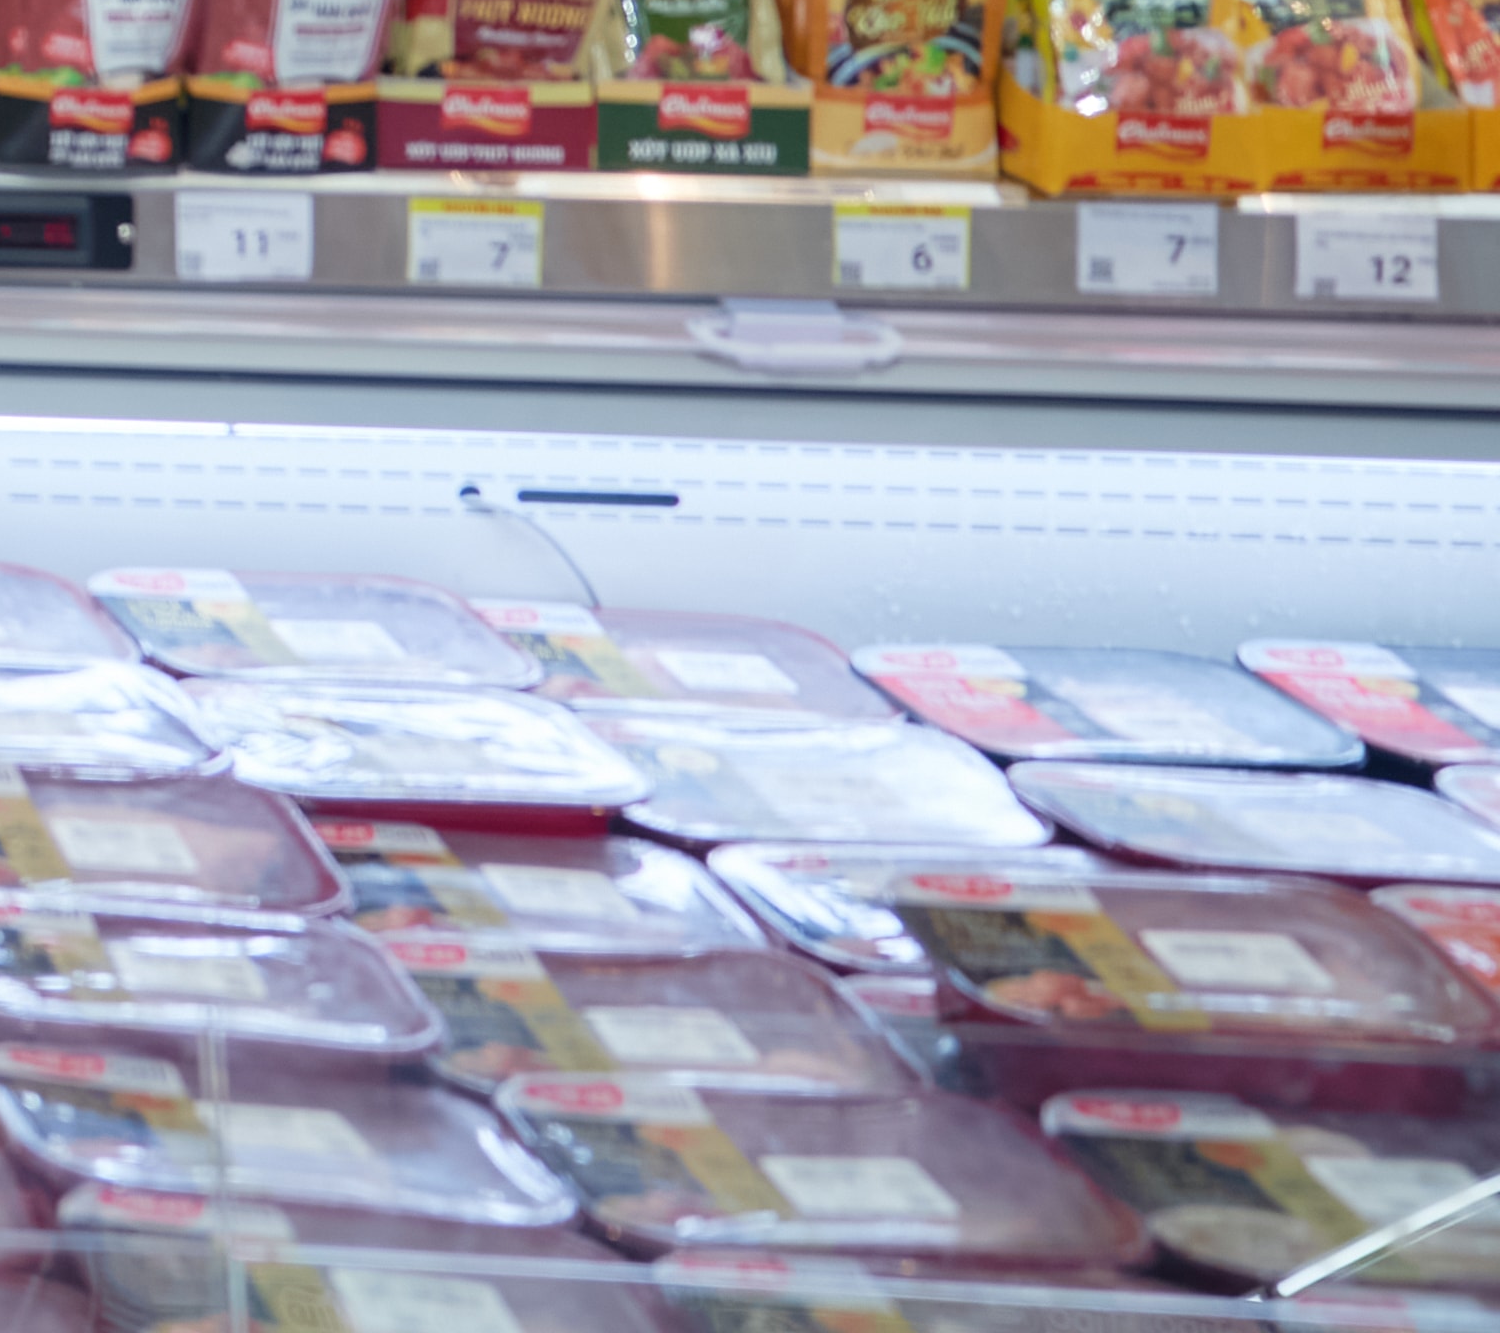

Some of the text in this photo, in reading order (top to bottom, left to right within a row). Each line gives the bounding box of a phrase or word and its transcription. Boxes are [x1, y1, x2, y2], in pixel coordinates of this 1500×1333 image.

[231, 229, 270, 255] 11
[1165, 235, 1186, 264] 7
[911, 244, 933, 273] 6
[1368, 253, 1410, 284] 12
